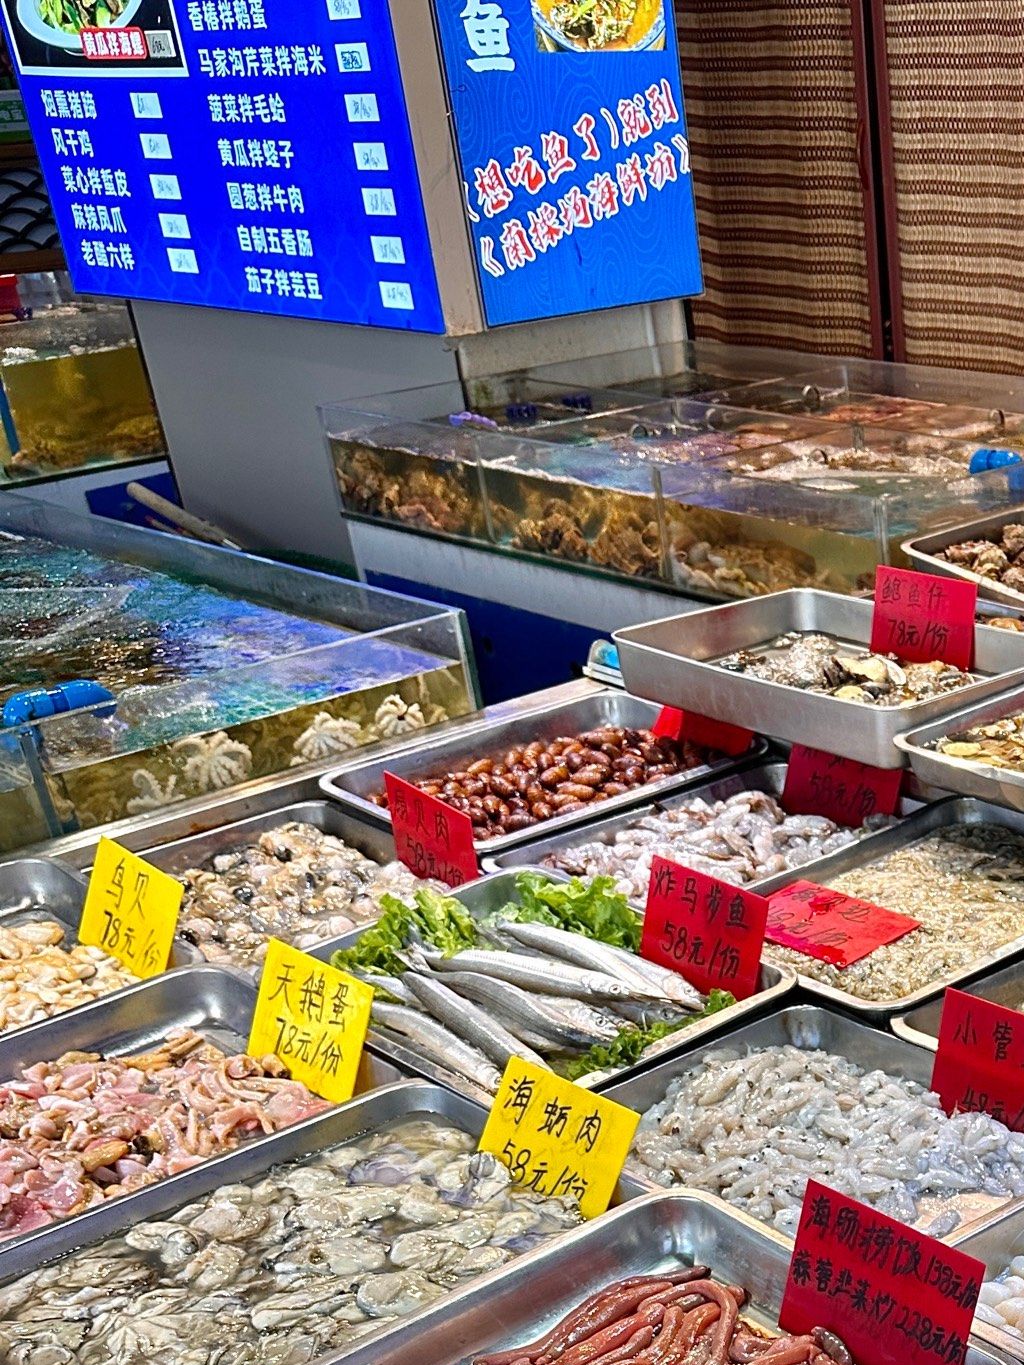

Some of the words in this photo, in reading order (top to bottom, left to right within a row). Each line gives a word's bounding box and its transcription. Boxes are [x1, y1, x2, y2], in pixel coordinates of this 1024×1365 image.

[198, 47, 327, 78] 马家沟芹菜拌海米
[51, 128, 95, 158] 风干鸡
[217, 138, 295, 169] 黄瓜拌蛏子
[71, 203, 127, 234] 麻辣凤爪
[236, 225, 313, 258] 自制五香肠
[244, 267, 323, 300] 茄子拌芸豆
[102, 910, 162, 972] 78元/份
[661, 919, 740, 979] 58元/份
[268, 964, 354, 1032] 天鹅蛋
[276, 1016, 344, 1077] 78元/份
